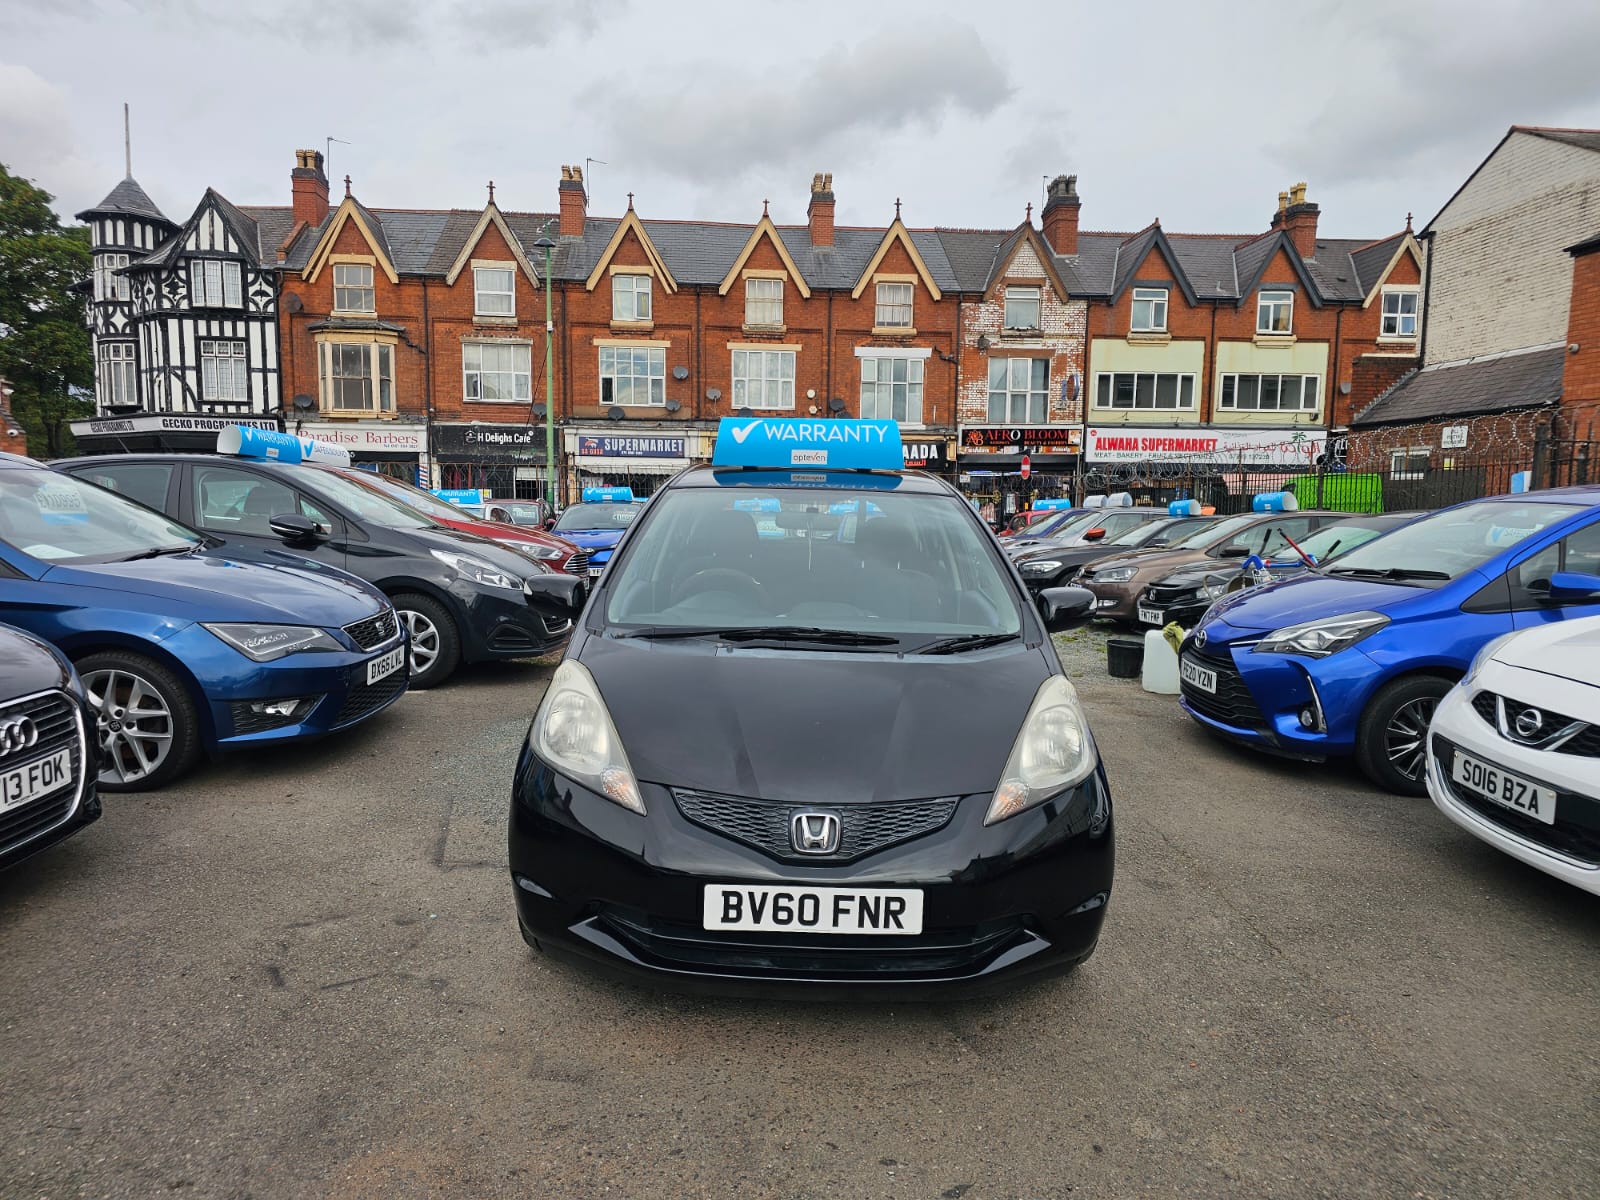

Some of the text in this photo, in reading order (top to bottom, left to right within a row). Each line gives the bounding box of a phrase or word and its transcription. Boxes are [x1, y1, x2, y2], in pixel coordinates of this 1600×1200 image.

[162, 418, 192, 429] GECKO
[254, 430, 296, 447] WARRANTY
[299, 430, 418, 444] Paradise Barbers
[477, 432, 484, 442] H
[764, 423, 888, 443] WARRANTY
[985, 429, 1069, 441] AFRO BLOOM
[604, 438, 683, 452] SUPERMARKET
[1095, 437, 1217, 452] ALWAHA SUPERMARKET
[793, 452, 826, 463] opteven
[371, 656, 390, 679] DX66
[1197, 668, 1213, 690] YZN
[28, 754, 65, 794] FOK
[1462, 759, 1539, 815] SO16 BZA
[720, 890, 907, 930] BV60 FNR
